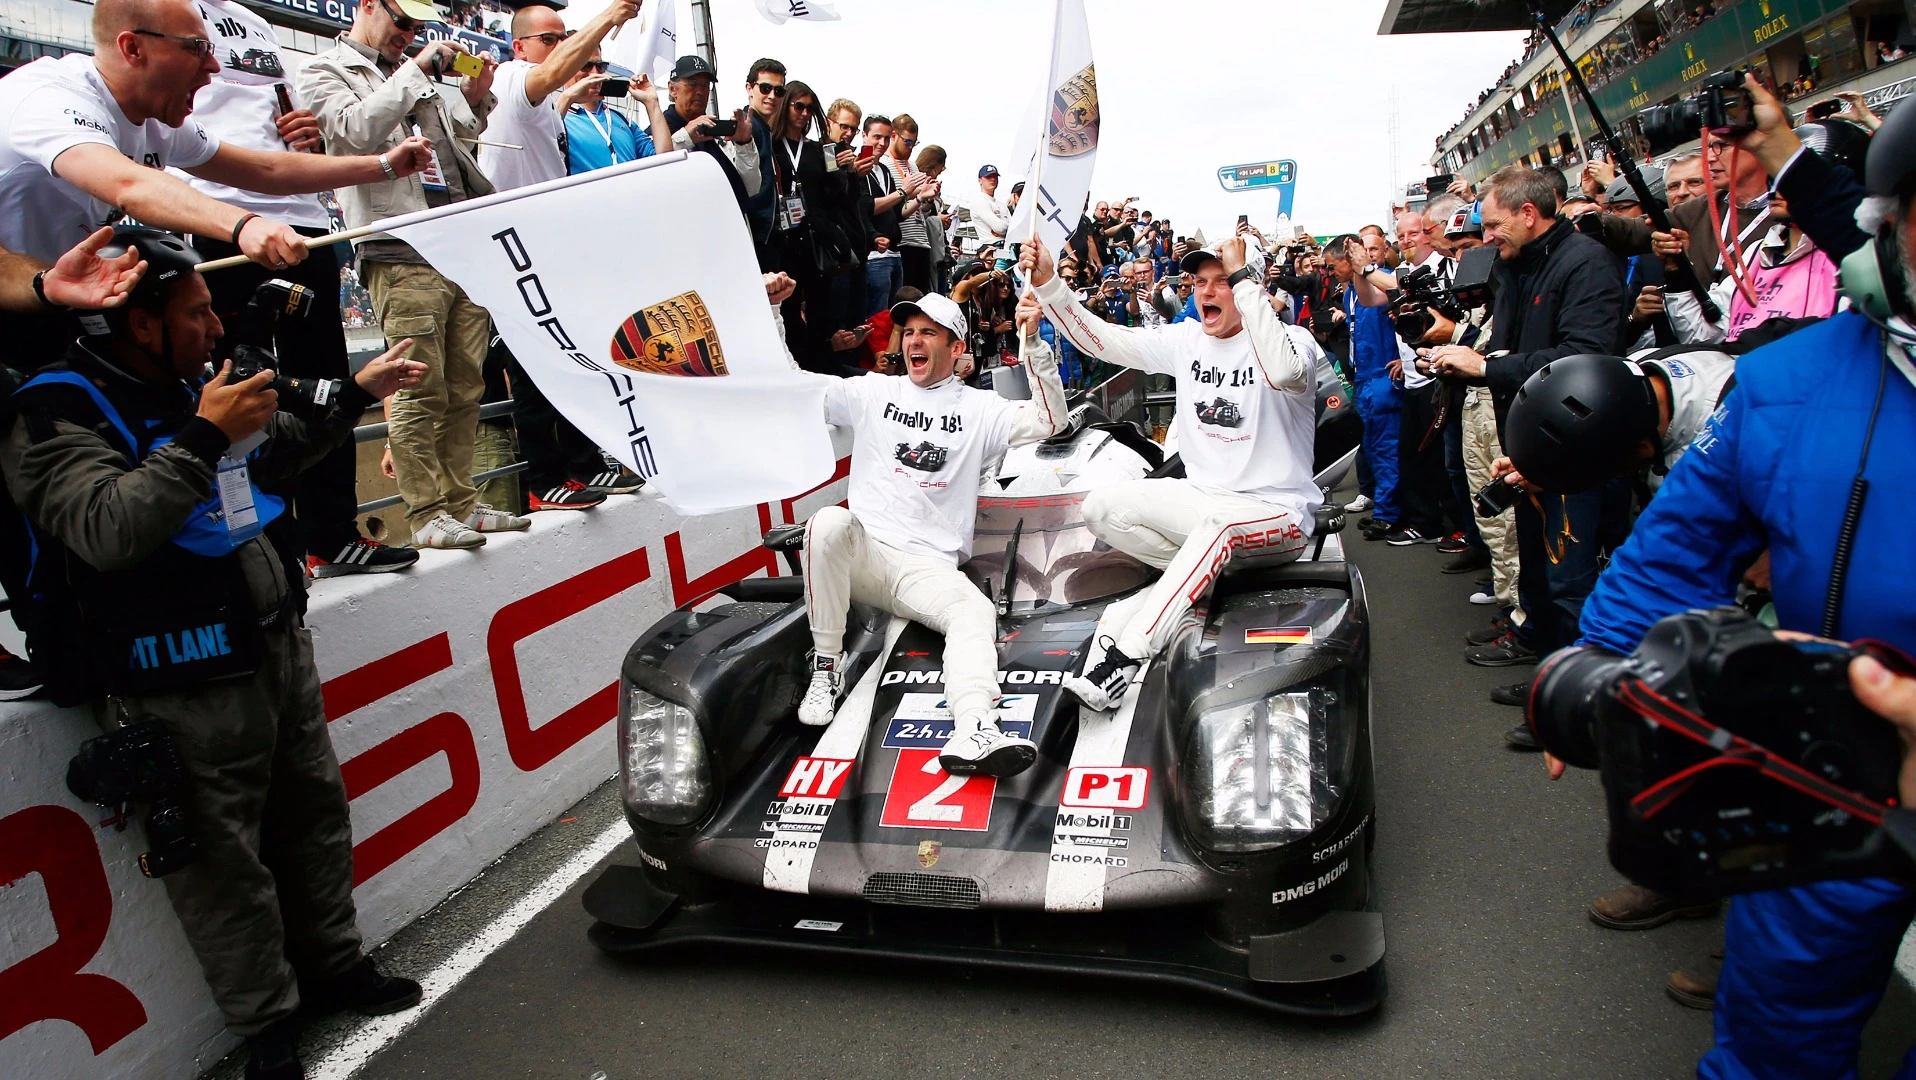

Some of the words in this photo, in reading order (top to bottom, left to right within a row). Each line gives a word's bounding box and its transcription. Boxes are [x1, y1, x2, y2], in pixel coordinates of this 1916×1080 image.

[1753, 14, 1789, 44] ROLEX
[1681, 59, 1708, 82] ROLEX
[1629, 91, 1650, 110] ROLEX
[1269, 165, 1276, 174] 8
[685, 291, 728, 377] PORSCHE
[1064, 304, 1105, 352] PORSCHE
[491, 226, 659, 480] PORSCHE
[883, 402, 934, 432] Finally
[940, 414, 963, 434] 18!
[165, 623, 232, 664] LANE
[998, 670, 1073, 685] ORI
[895, 723, 935, 738] 24h
[782, 759, 852, 795] HY
[907, 755, 973, 822] 2
[1077, 773, 1133, 801] P1
[768, 802, 815, 816] Mobil
[780, 823, 824, 832] MICHELIN
[1056, 813, 1110, 829] Mobil
[755, 839, 818, 849] CHOPARD
[1075, 835, 1127, 847] MICHELIN
[1051, 853, 1126, 866] CHOPARD
[1271, 880, 1316, 905] DMG
[1317, 857, 1349, 890] MORI
